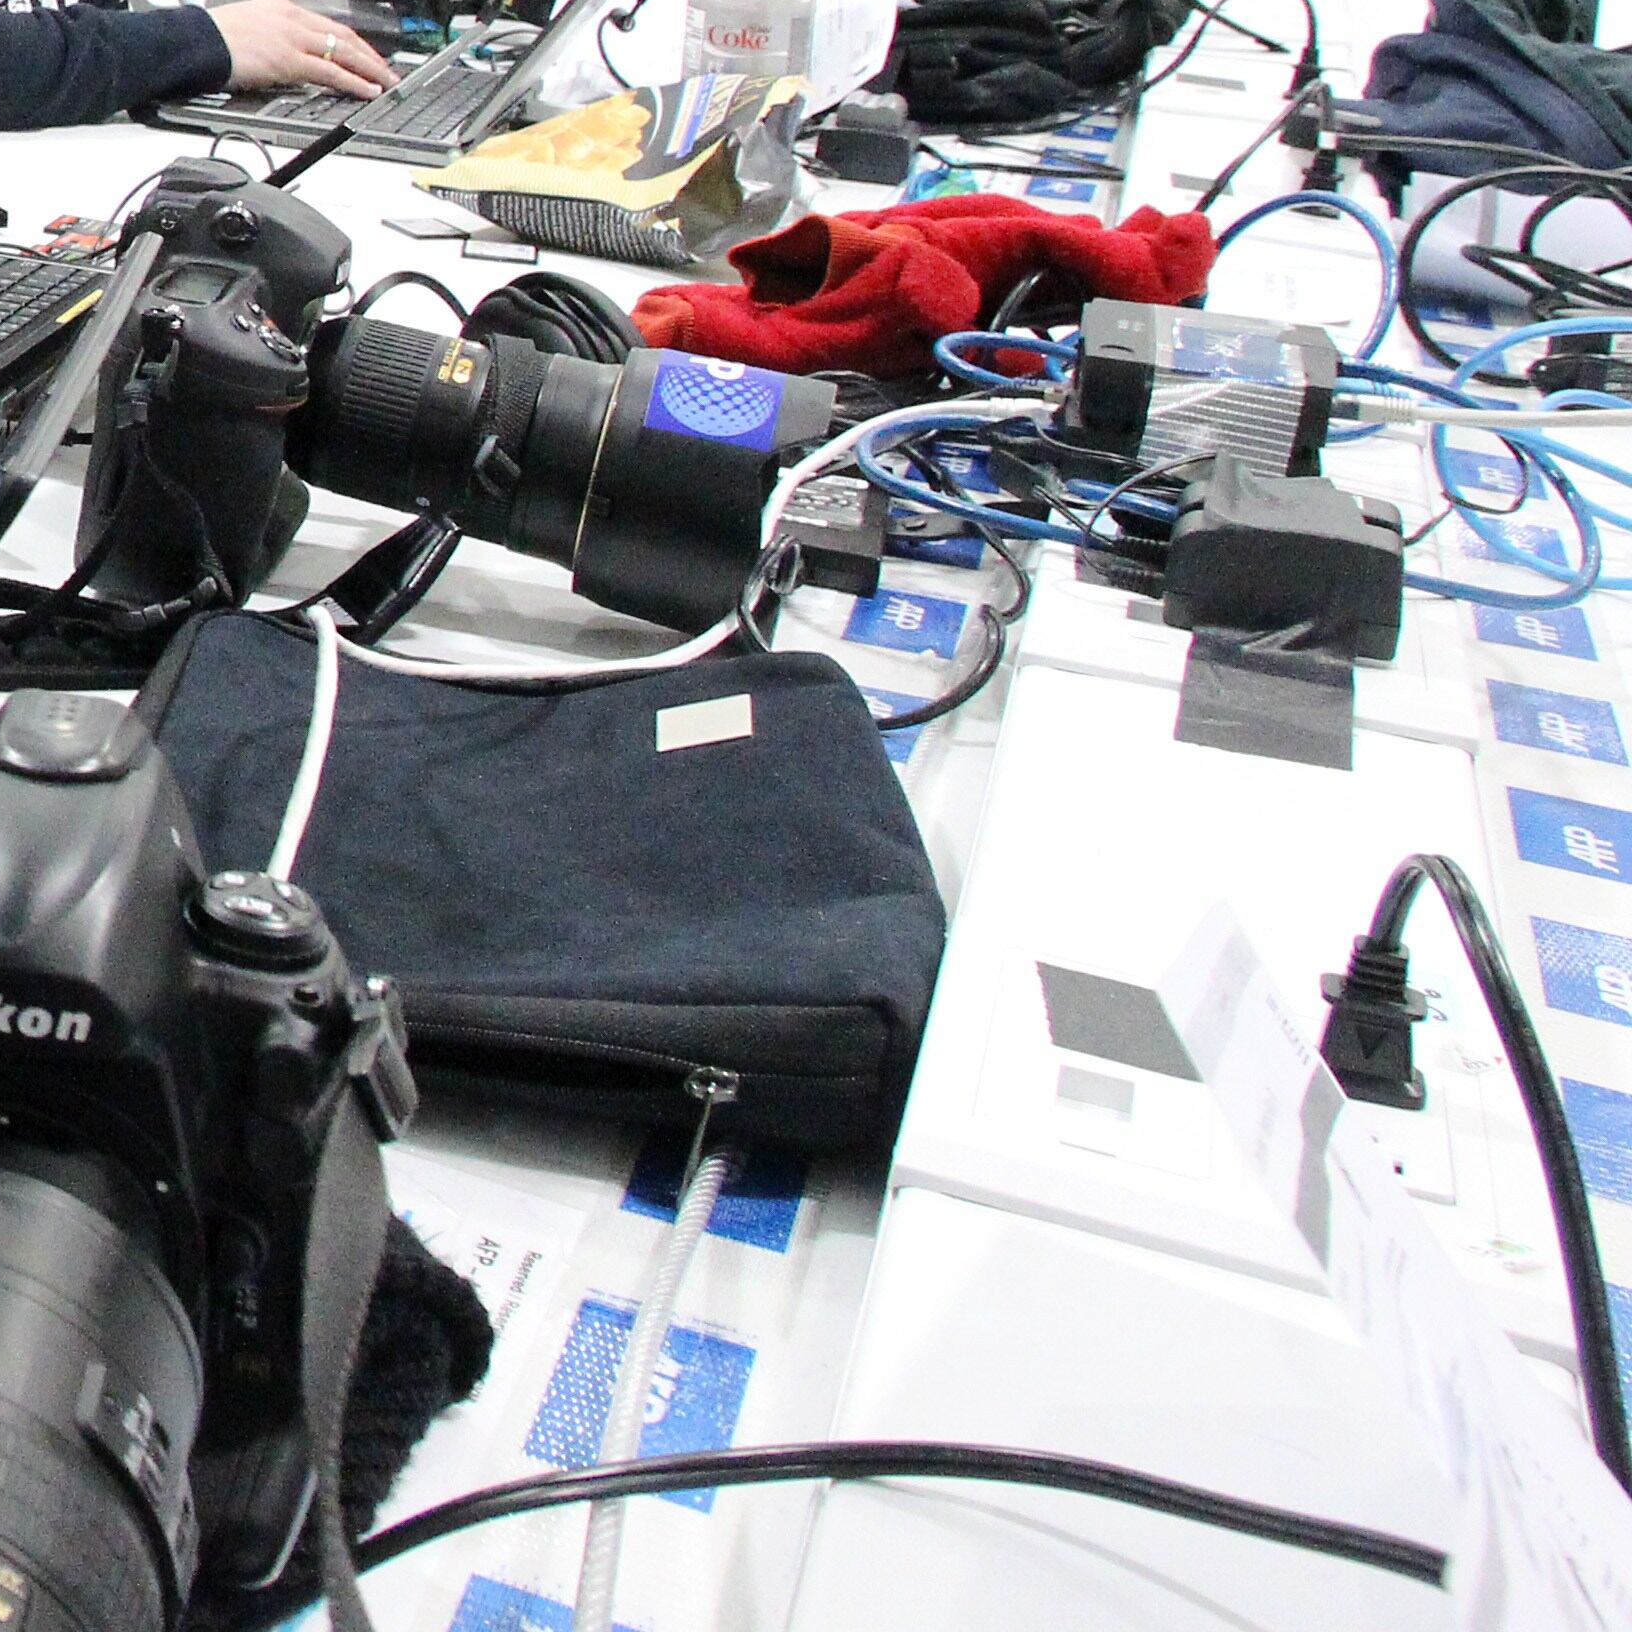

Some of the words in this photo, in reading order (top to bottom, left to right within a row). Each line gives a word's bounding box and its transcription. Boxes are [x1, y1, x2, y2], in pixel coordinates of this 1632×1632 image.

[707, 24, 770, 50] Coke
[1514, 615, 1563, 649] AFP
[1537, 711, 1590, 752] AFP
[1562, 824, 1620, 875] AFP
[477, 1236, 502, 1269] AFP
[511, 1250, 543, 1300] Reserved
